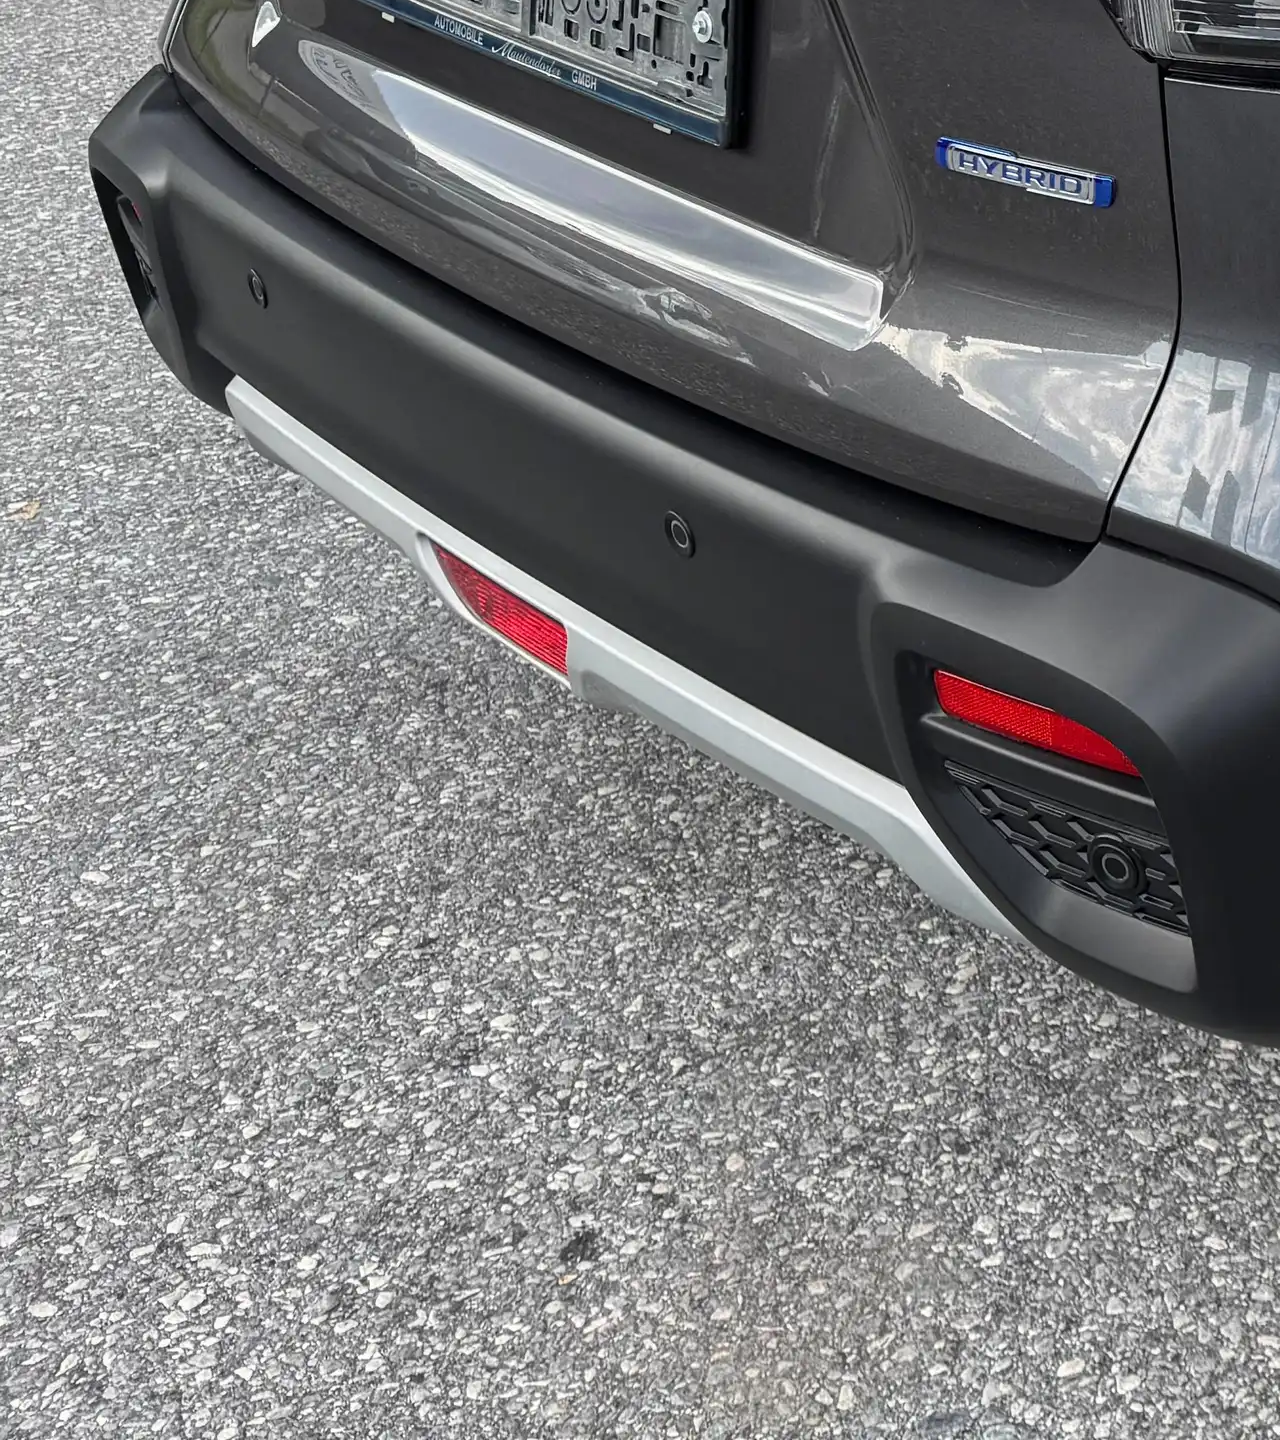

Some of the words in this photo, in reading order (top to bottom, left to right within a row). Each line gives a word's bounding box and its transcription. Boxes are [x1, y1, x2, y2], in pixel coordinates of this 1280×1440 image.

[434, 14, 484, 46] AUTOMOBILE
[571, 70, 598, 91] GMBH
[958, 152, 1083, 197] HYBRID
